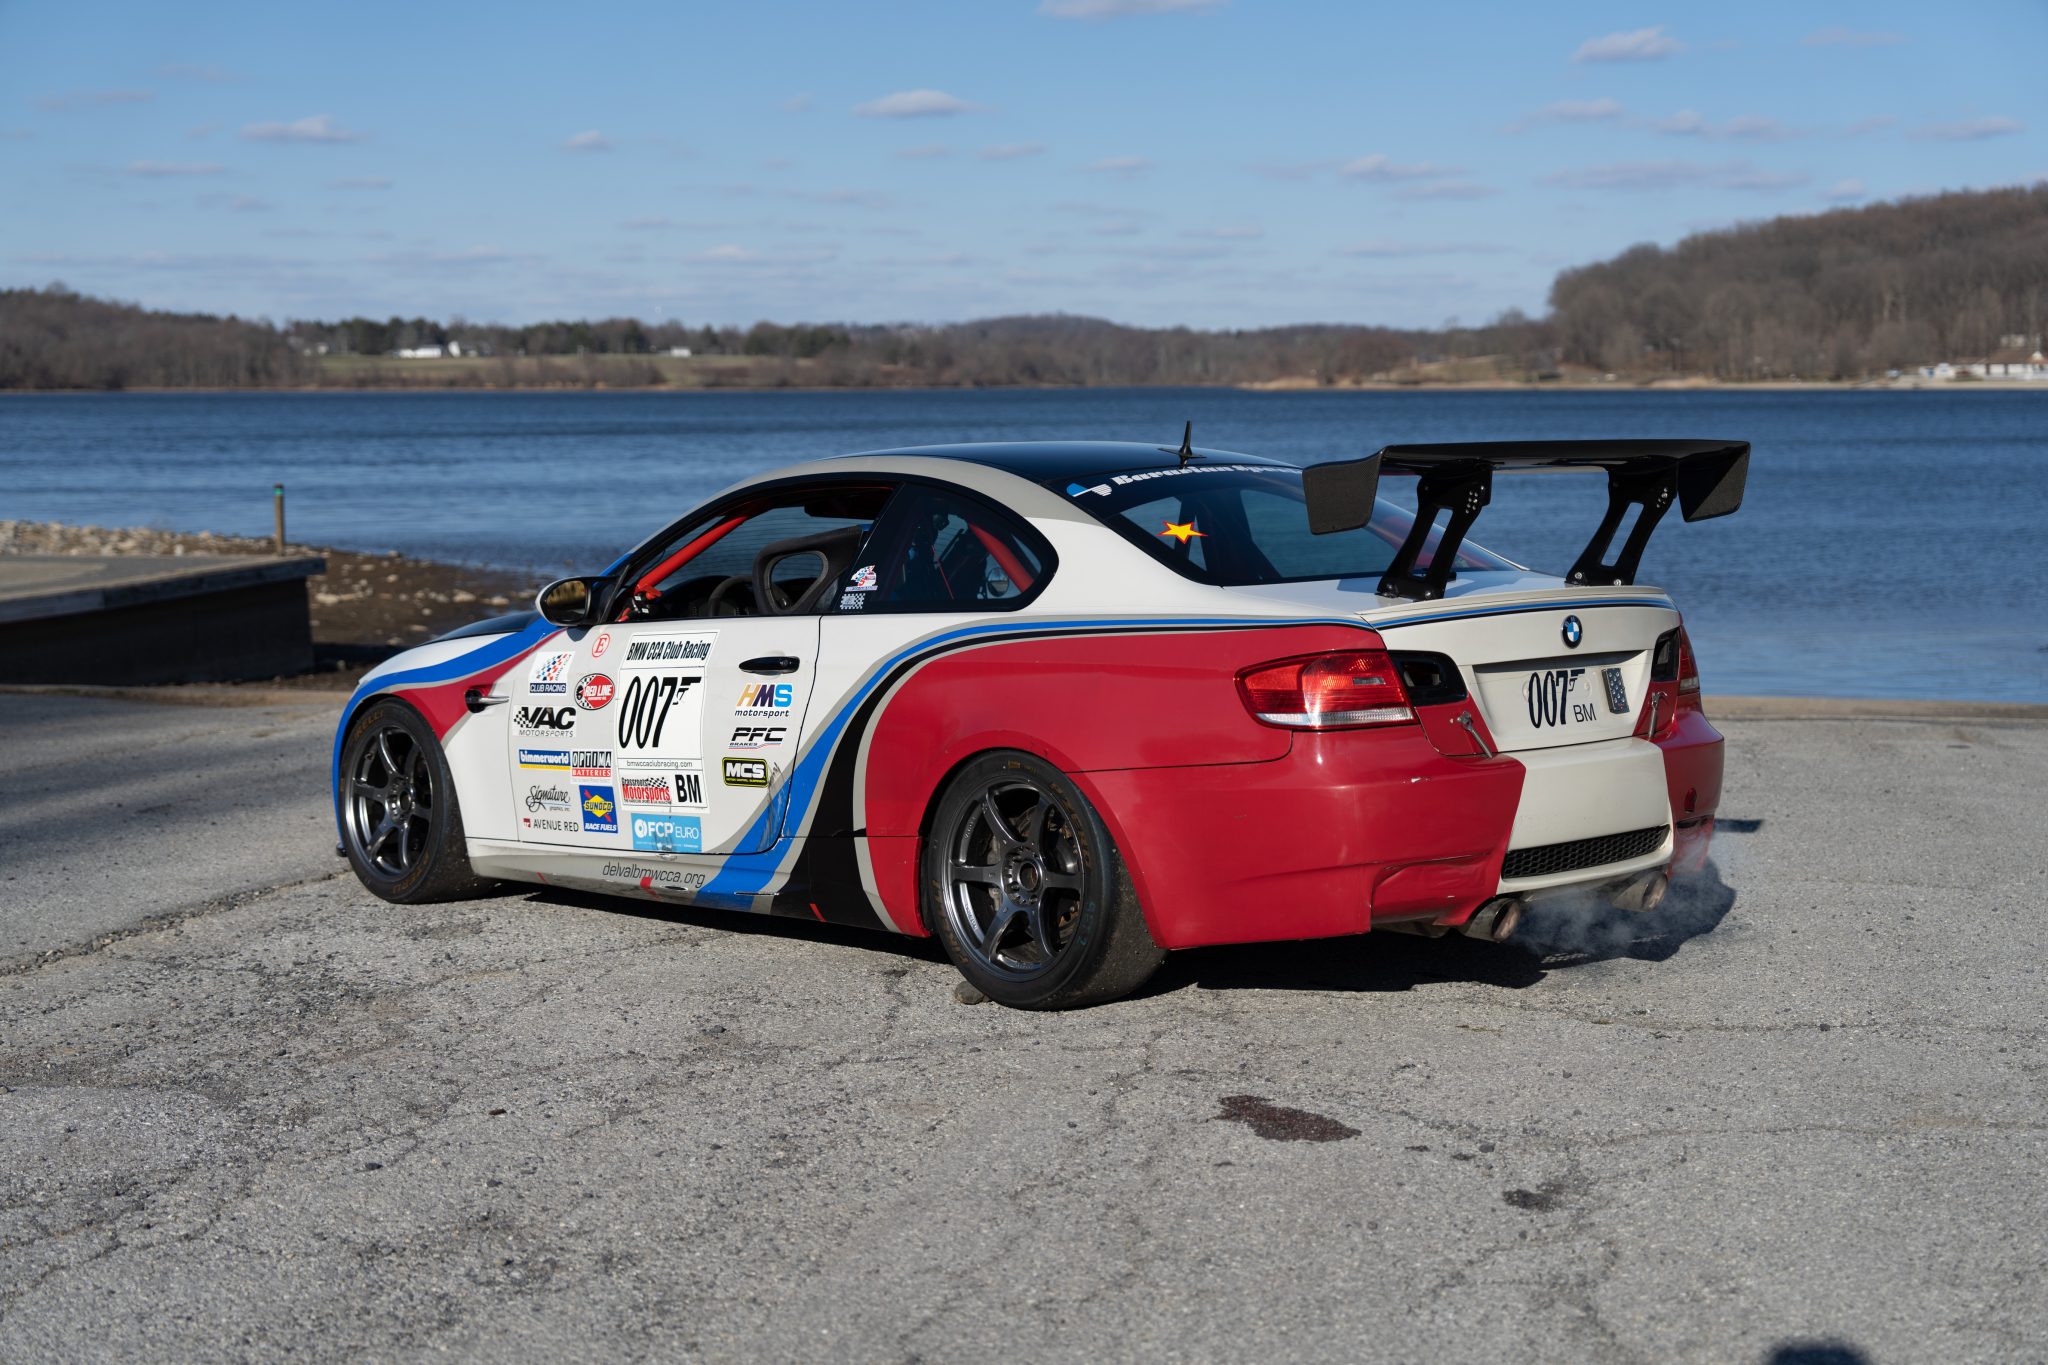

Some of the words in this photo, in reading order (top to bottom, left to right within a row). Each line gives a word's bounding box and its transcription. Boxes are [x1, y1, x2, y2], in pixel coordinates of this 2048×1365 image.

[595, 637, 607, 654] E
[626, 642, 650, 661] BMW
[646, 641, 665, 660] CCA
[662, 640, 684, 659] Club
[680, 639, 712, 661] Racing
[530, 684, 544, 692] CLUB
[545, 684, 566, 692] RACING
[586, 685, 598, 697] RED
[597, 684, 613, 697] LINE
[736, 684, 793, 707] HMS
[1528, 669, 1568, 729] 007
[517, 706, 576, 730] VAC
[734, 709, 790, 719] motorsport
[1573, 703, 1597, 723] BM
[519, 729, 574, 738] MOTORSPORTS
[731, 727, 788, 742] PFC
[520, 750, 569, 764] bimmerworld
[572, 751, 612, 768] OPTIMA
[626, 760, 693, 769] bmwccaclubracing.com
[726, 762, 765, 779] MCS
[622, 784, 671, 804] Motorsports
[675, 774, 702, 804] BM
[526, 785, 571, 813] Signature
[585, 801, 613, 811] SUNOCO
[533, 819, 562, 831] AVENUE
[563, 821, 579, 832] RED
[585, 822, 601, 831] RACE
[600, 823, 617, 832] FUELS
[648, 821, 674, 838] FCP
[675, 826, 699, 840] EURO
[603, 862, 706, 889] delvalbmwcca.org
